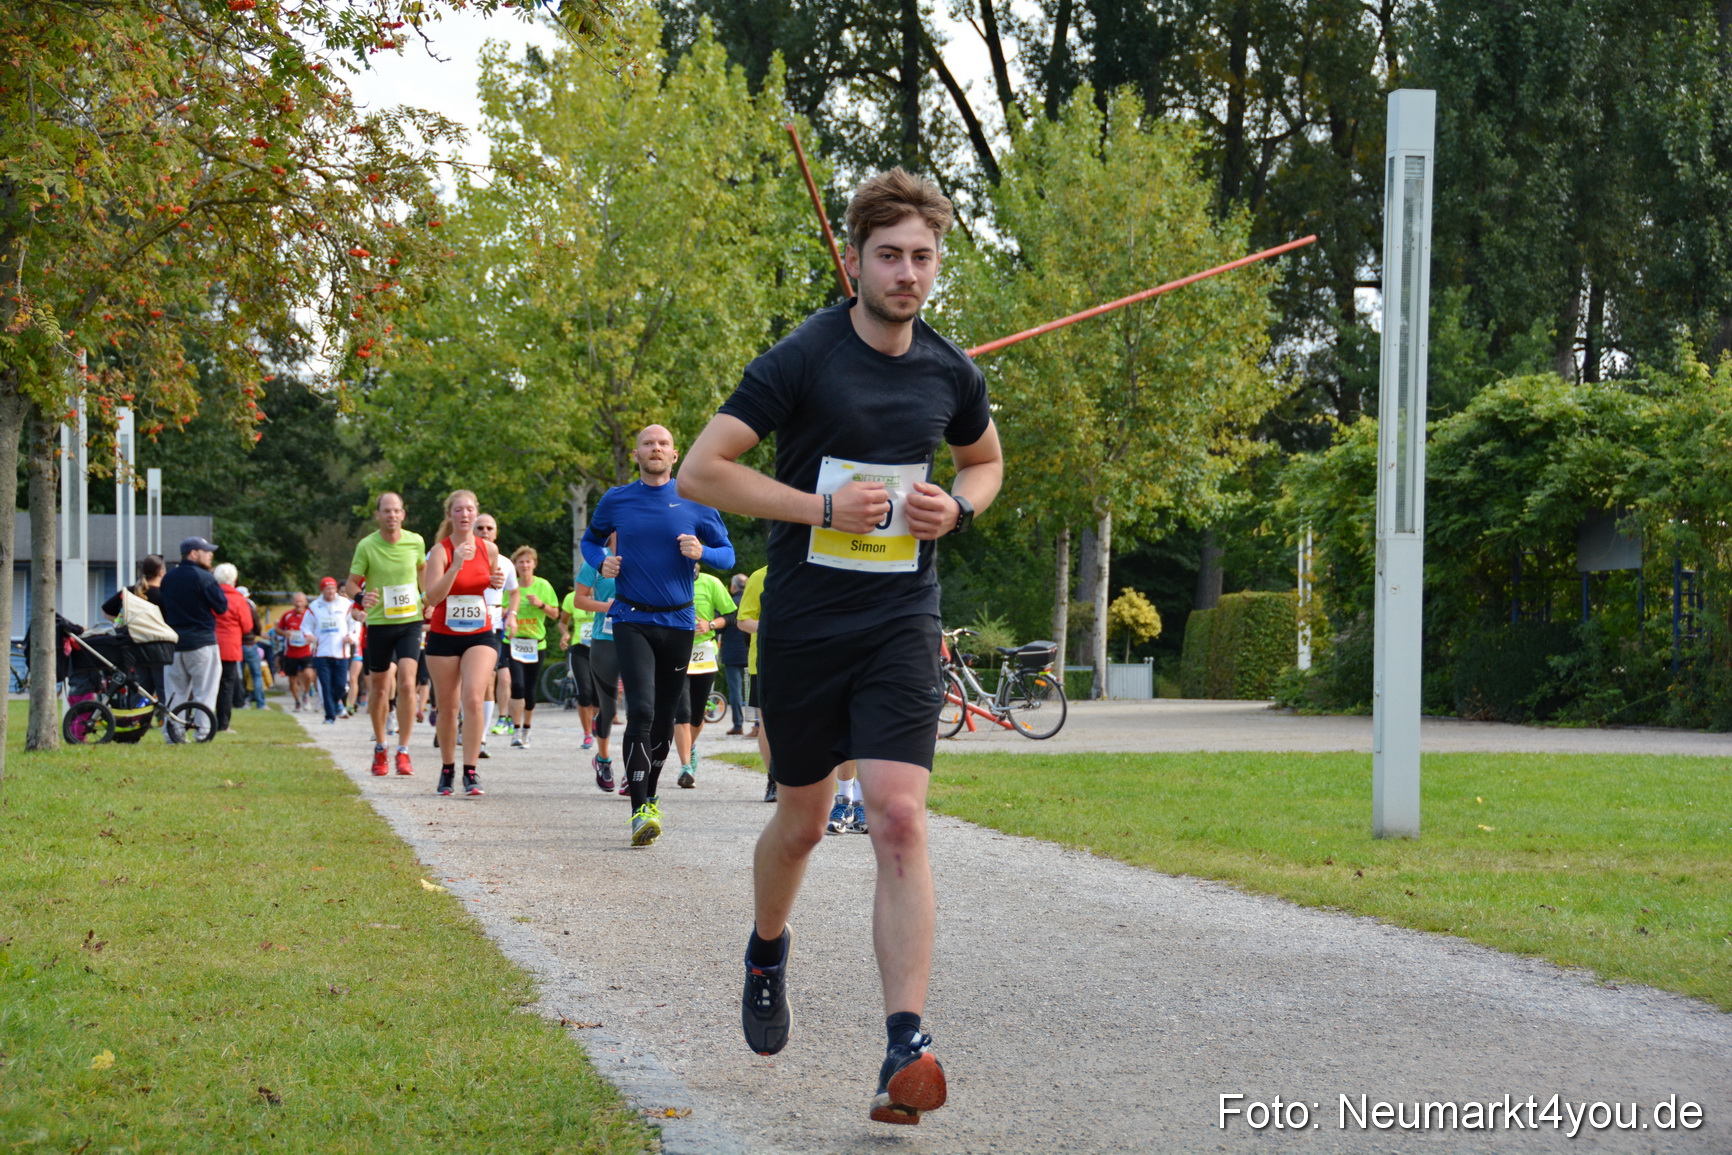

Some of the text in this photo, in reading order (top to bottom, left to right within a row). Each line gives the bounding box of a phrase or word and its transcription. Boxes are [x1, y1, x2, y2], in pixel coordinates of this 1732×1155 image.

[850, 540, 886, 553] Simon
[393, 594, 410, 606] 195
[452, 606, 481, 618] 2153
[514, 644, 534, 653] 2203
[692, 651, 704, 661] 22
